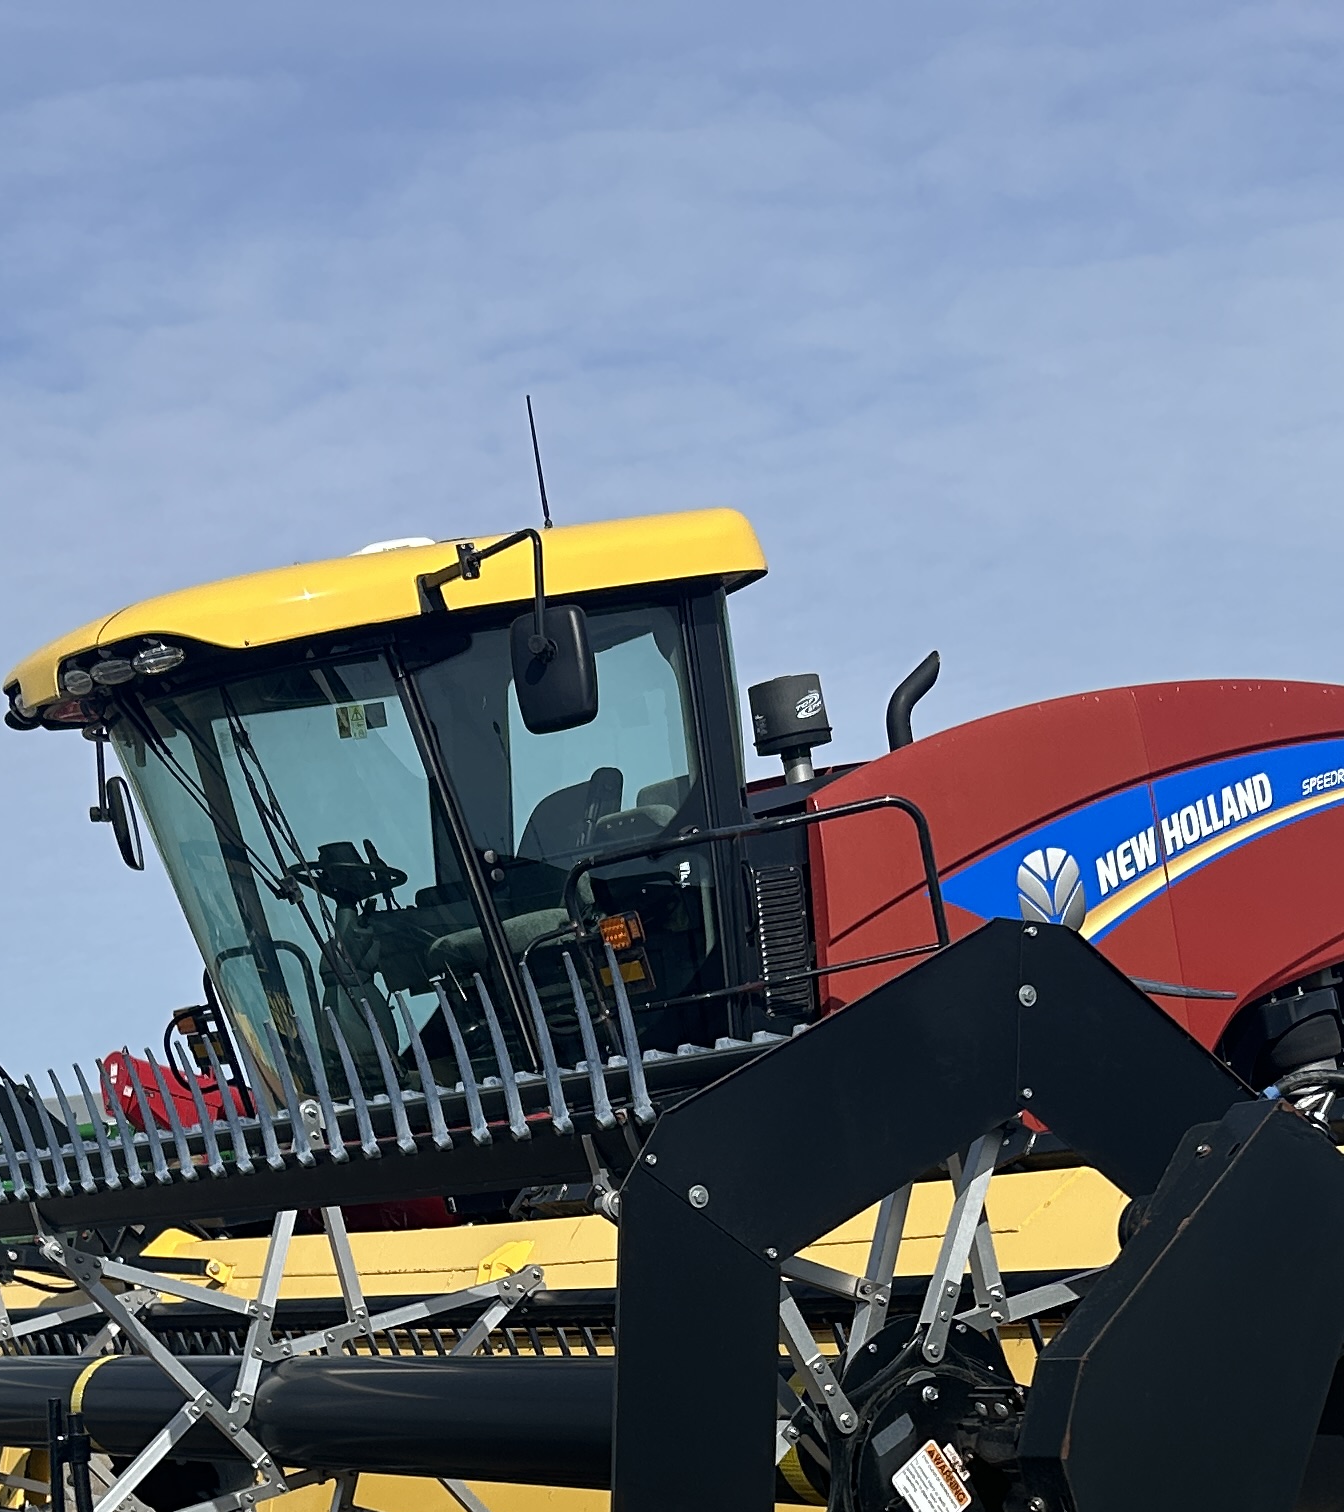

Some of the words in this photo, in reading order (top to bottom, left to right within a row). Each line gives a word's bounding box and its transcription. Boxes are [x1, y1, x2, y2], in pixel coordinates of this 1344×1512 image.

[1095, 824, 1157, 895] NEW
[1161, 773, 1273, 856] HOLLAND
[931, 1455, 966, 1503] WARNING
